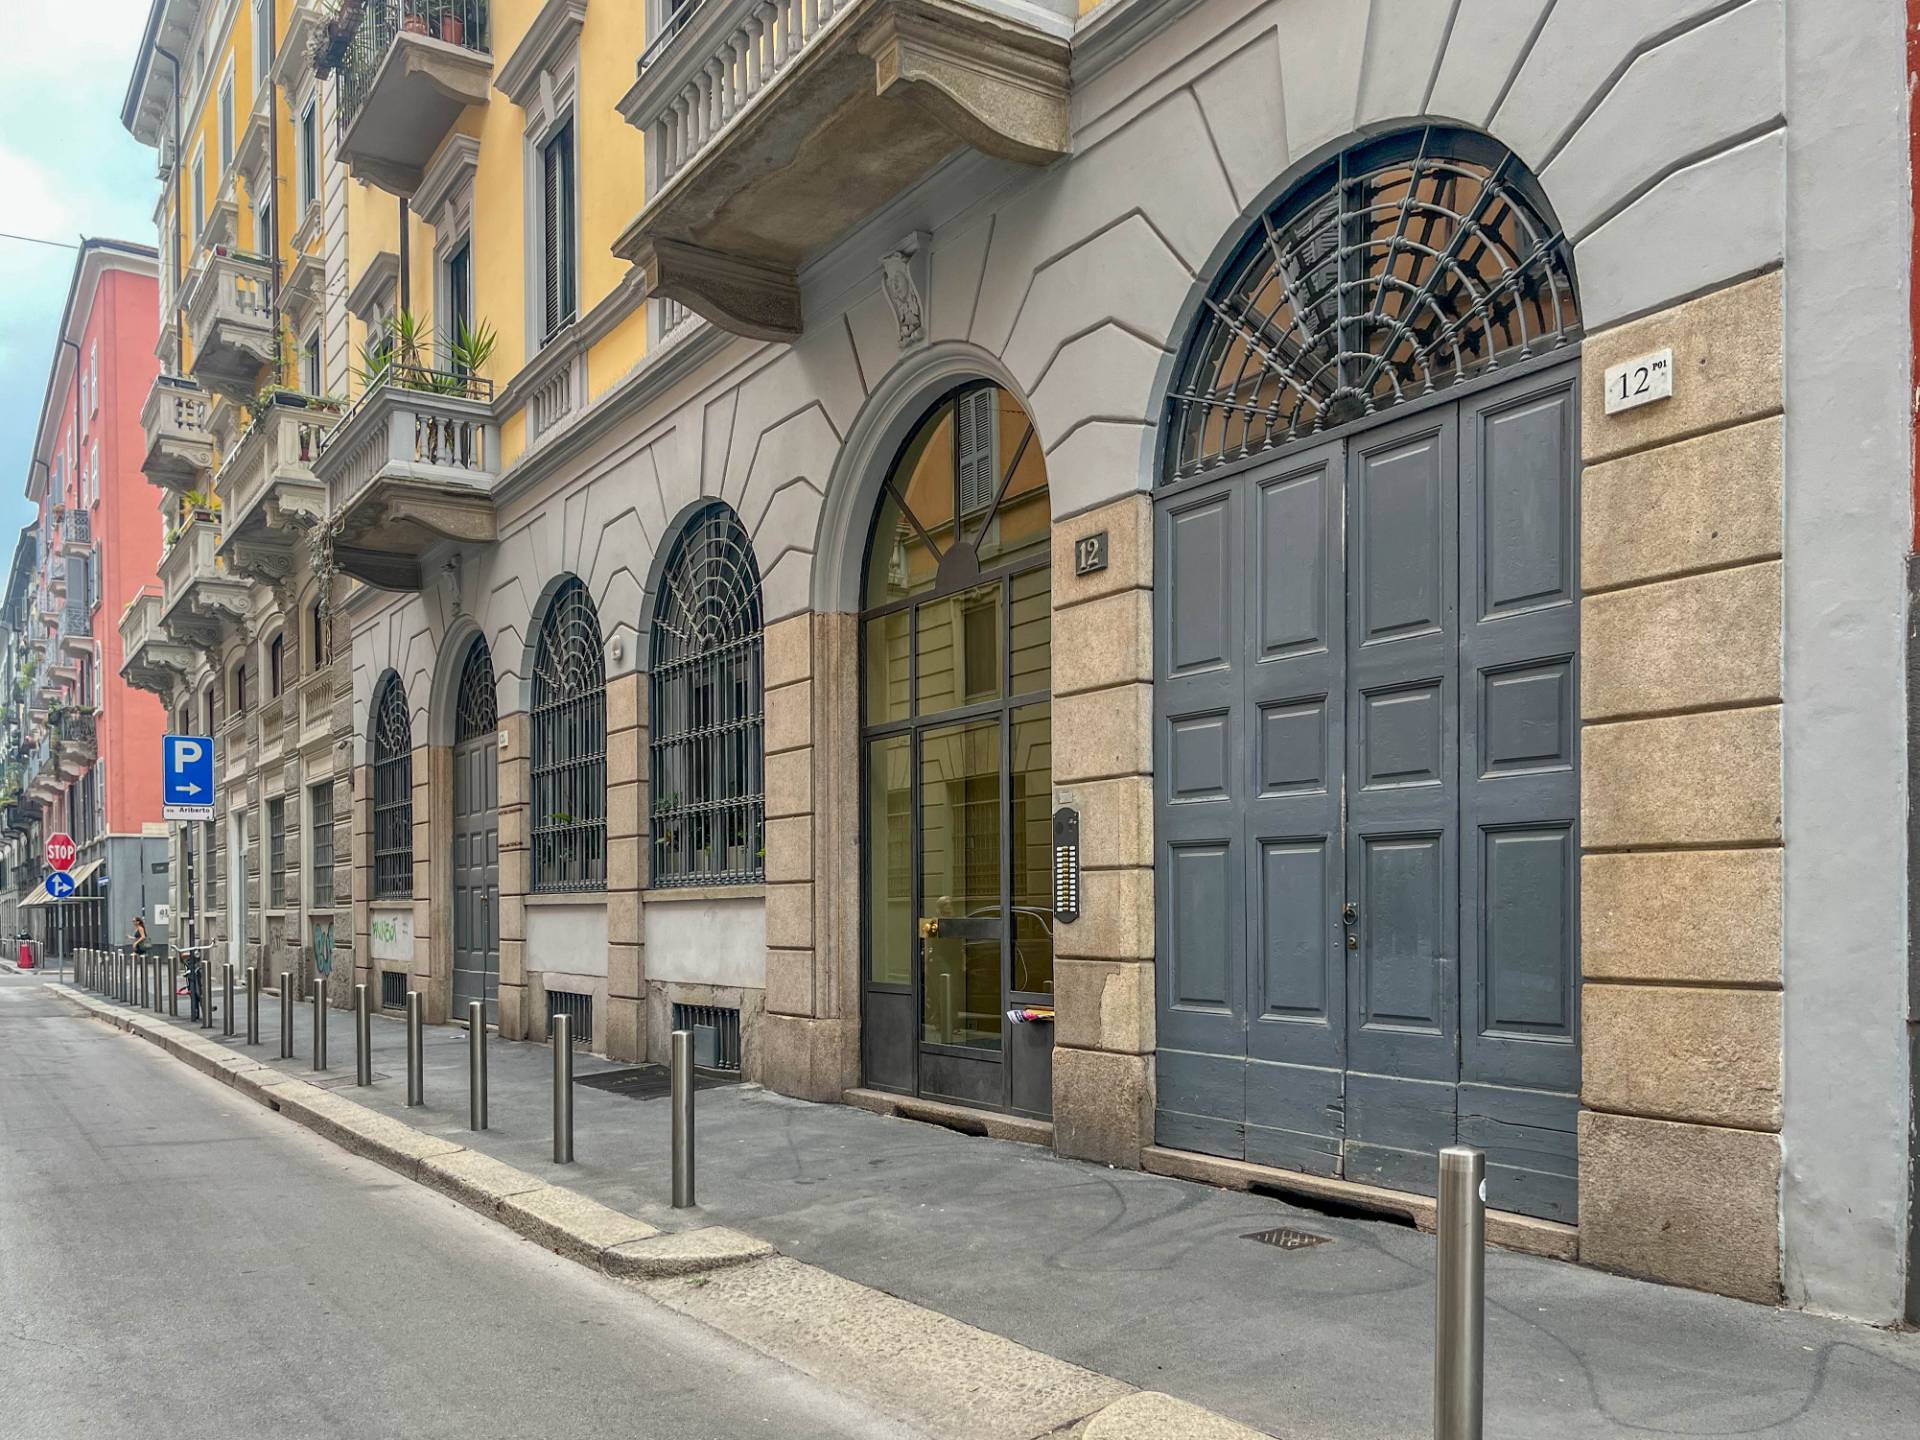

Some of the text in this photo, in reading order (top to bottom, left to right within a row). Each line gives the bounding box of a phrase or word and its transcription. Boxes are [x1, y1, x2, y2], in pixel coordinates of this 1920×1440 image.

[1619, 367, 1650, 400] 12
[1080, 538, 1099, 569] 12
[174, 740, 203, 773] P
[48, 844, 74, 860] STOP
